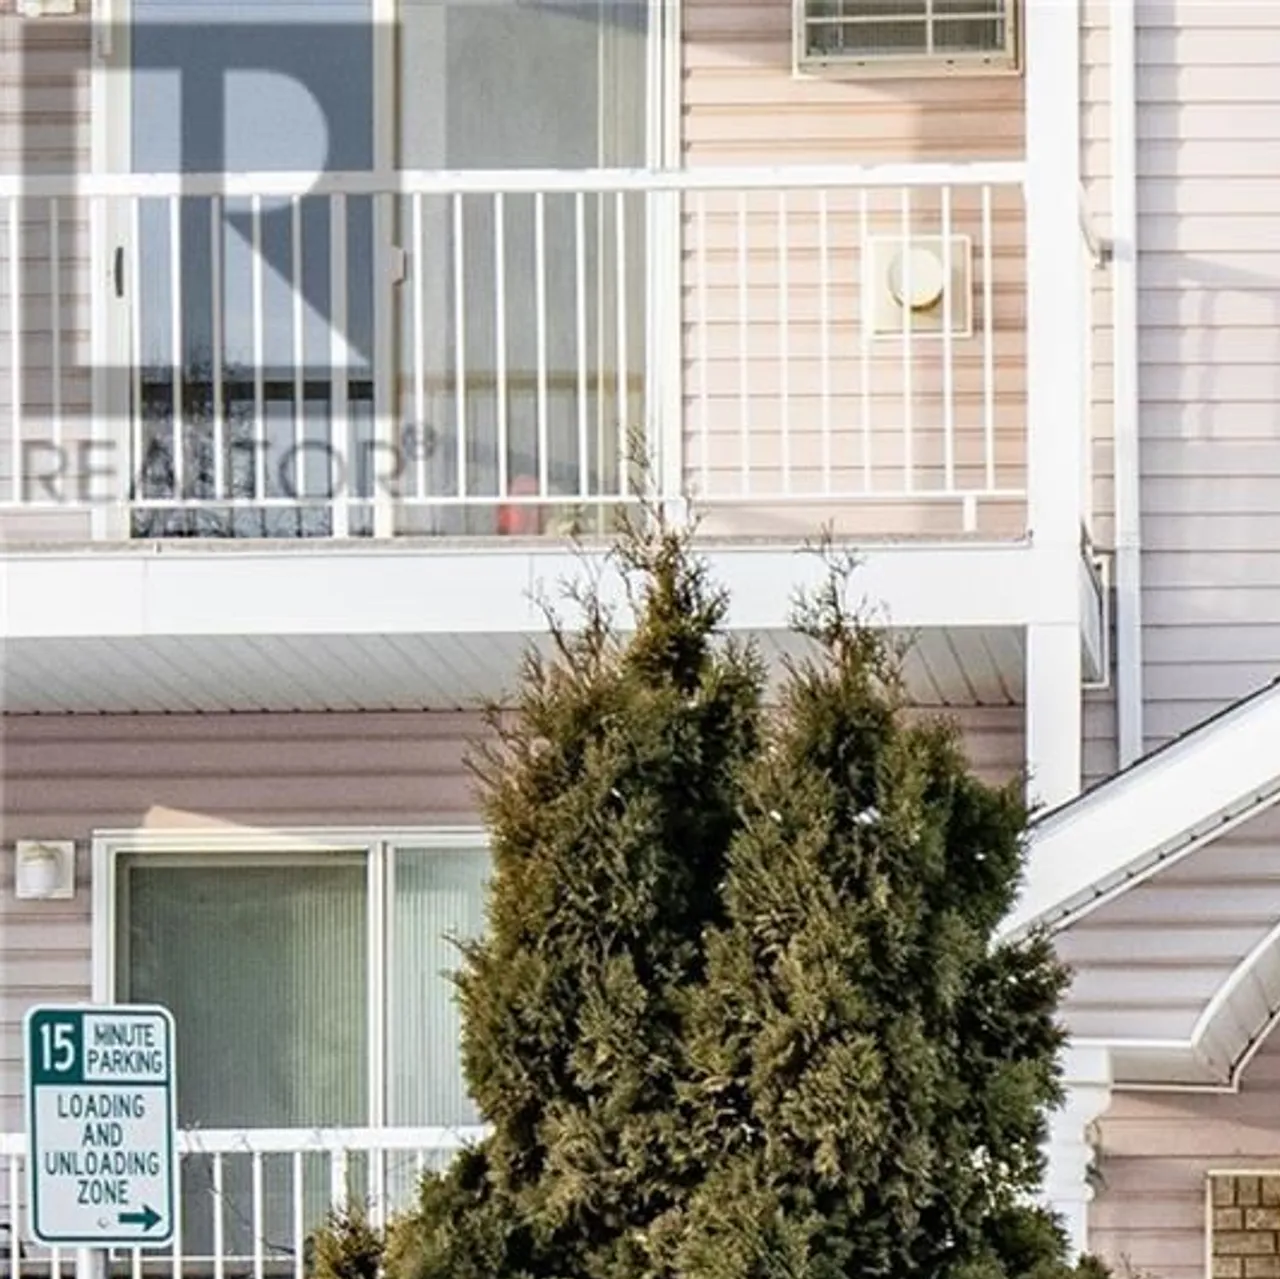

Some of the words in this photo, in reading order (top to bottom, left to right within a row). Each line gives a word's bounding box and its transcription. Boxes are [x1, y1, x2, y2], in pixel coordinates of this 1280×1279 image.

[40, 1022, 75, 1072] 15
[93, 1023, 155, 1047] MINUTE
[87, 1050, 163, 1074] PARKING
[57, 1094, 146, 1119] LOADING
[82, 1123, 123, 1148] AND
[45, 1152, 161, 1176] UNLOADING
[77, 1180, 130, 1205] ZONE
